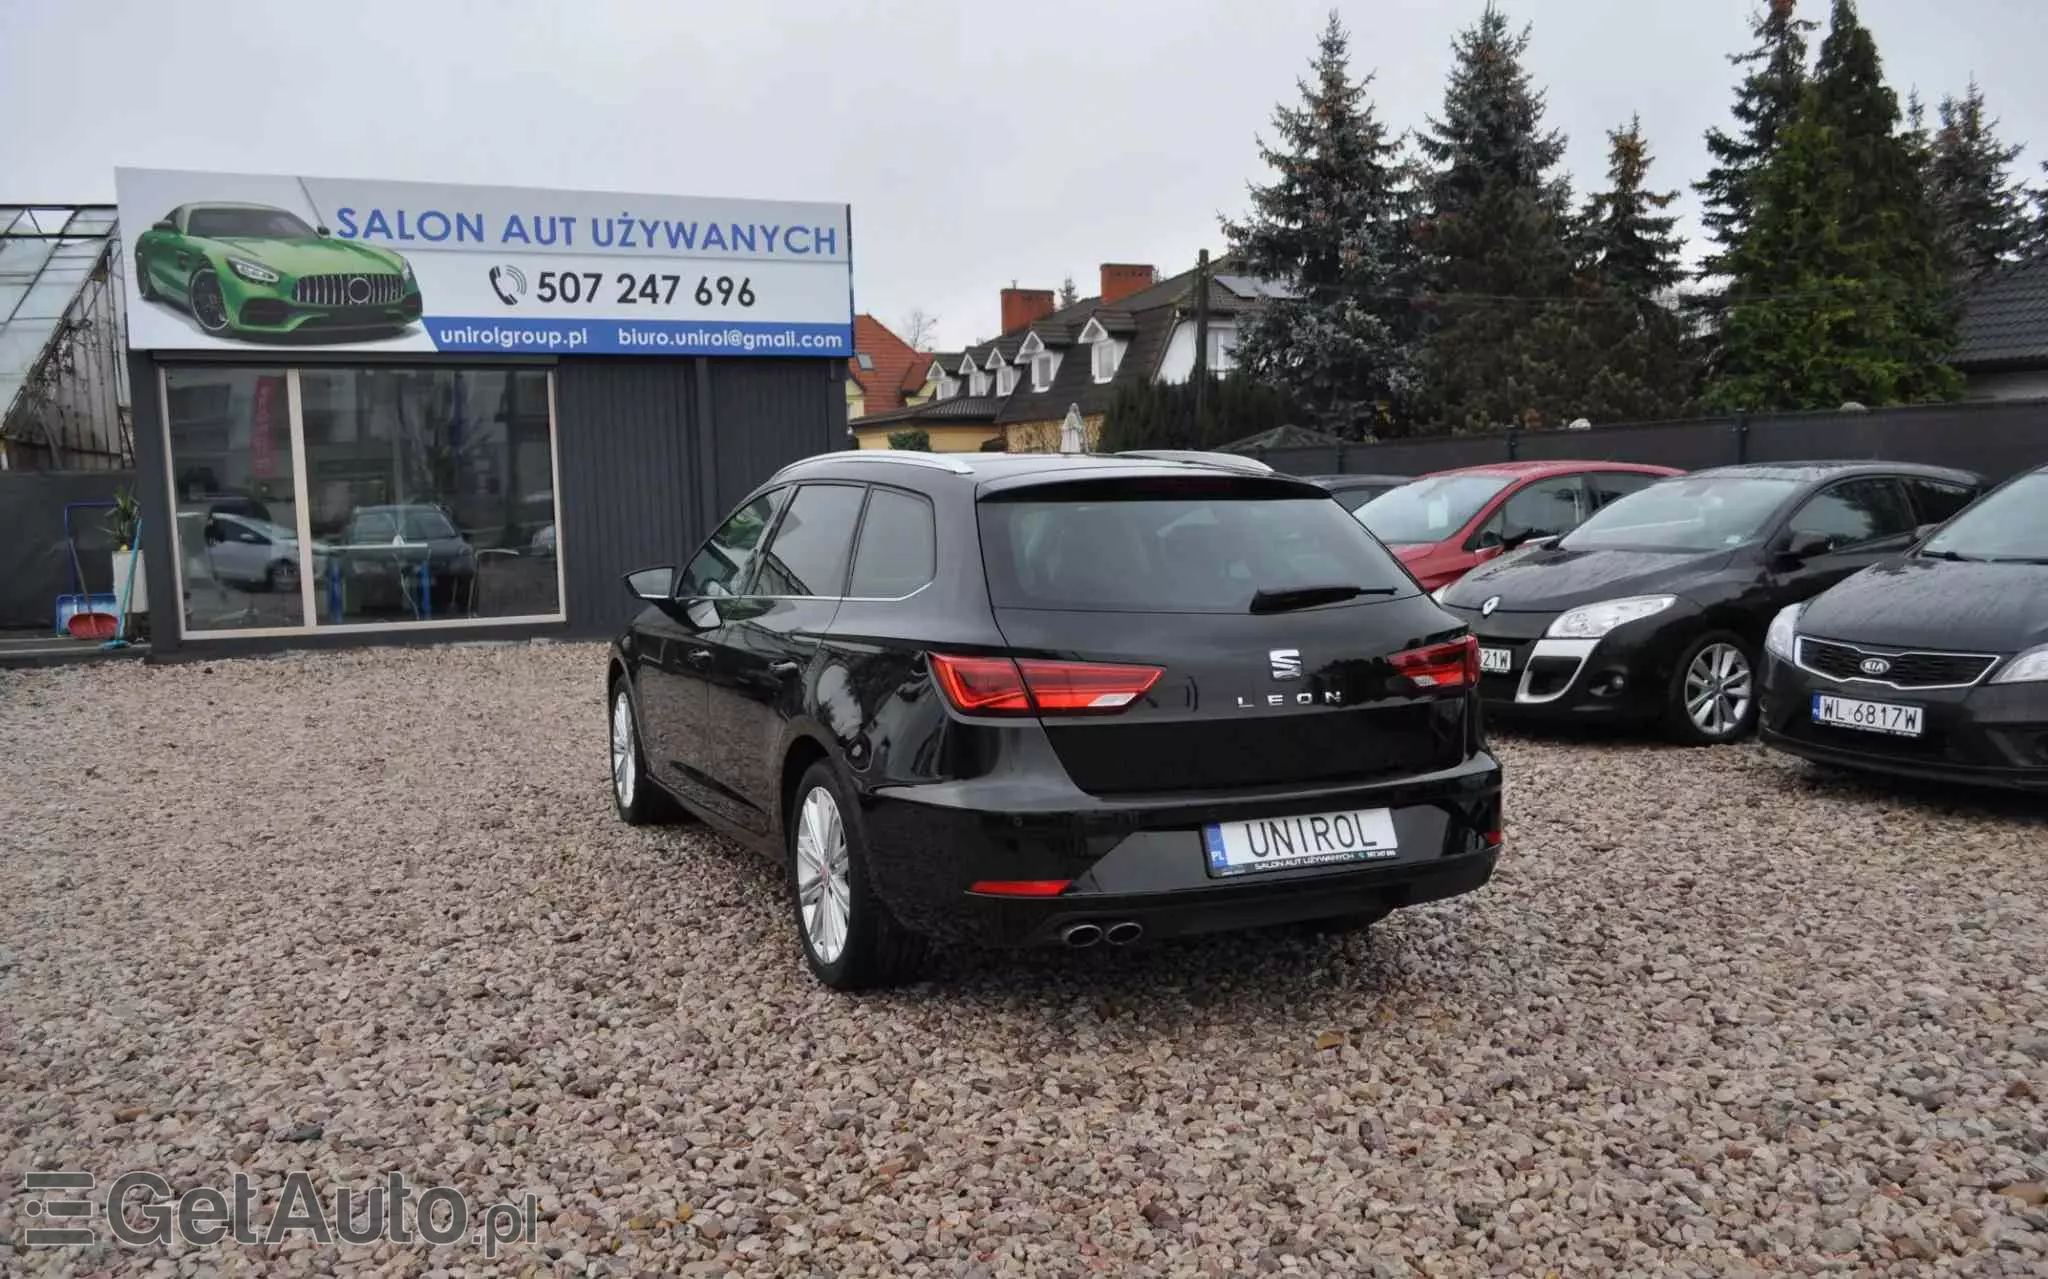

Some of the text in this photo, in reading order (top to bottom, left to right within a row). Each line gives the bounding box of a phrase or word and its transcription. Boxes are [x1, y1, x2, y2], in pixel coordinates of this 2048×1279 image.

[337, 207, 836, 255] SALON AUT UŻYWANYCH
[537, 271, 755, 307] 507 247 696
[440, 325, 843, 350] unirolgroup.pl biuro.unirol@gmail.com
[1482, 650, 1509, 669] 21W
[1864, 661, 1884, 673] KIA
[1237, 691, 1342, 708] LEON
[1823, 699, 1845, 721] WL
[1853, 703, 1917, 730] 6817W
[1245, 813, 1377, 858] UNIROL
[1211, 850, 1225, 861] PL
